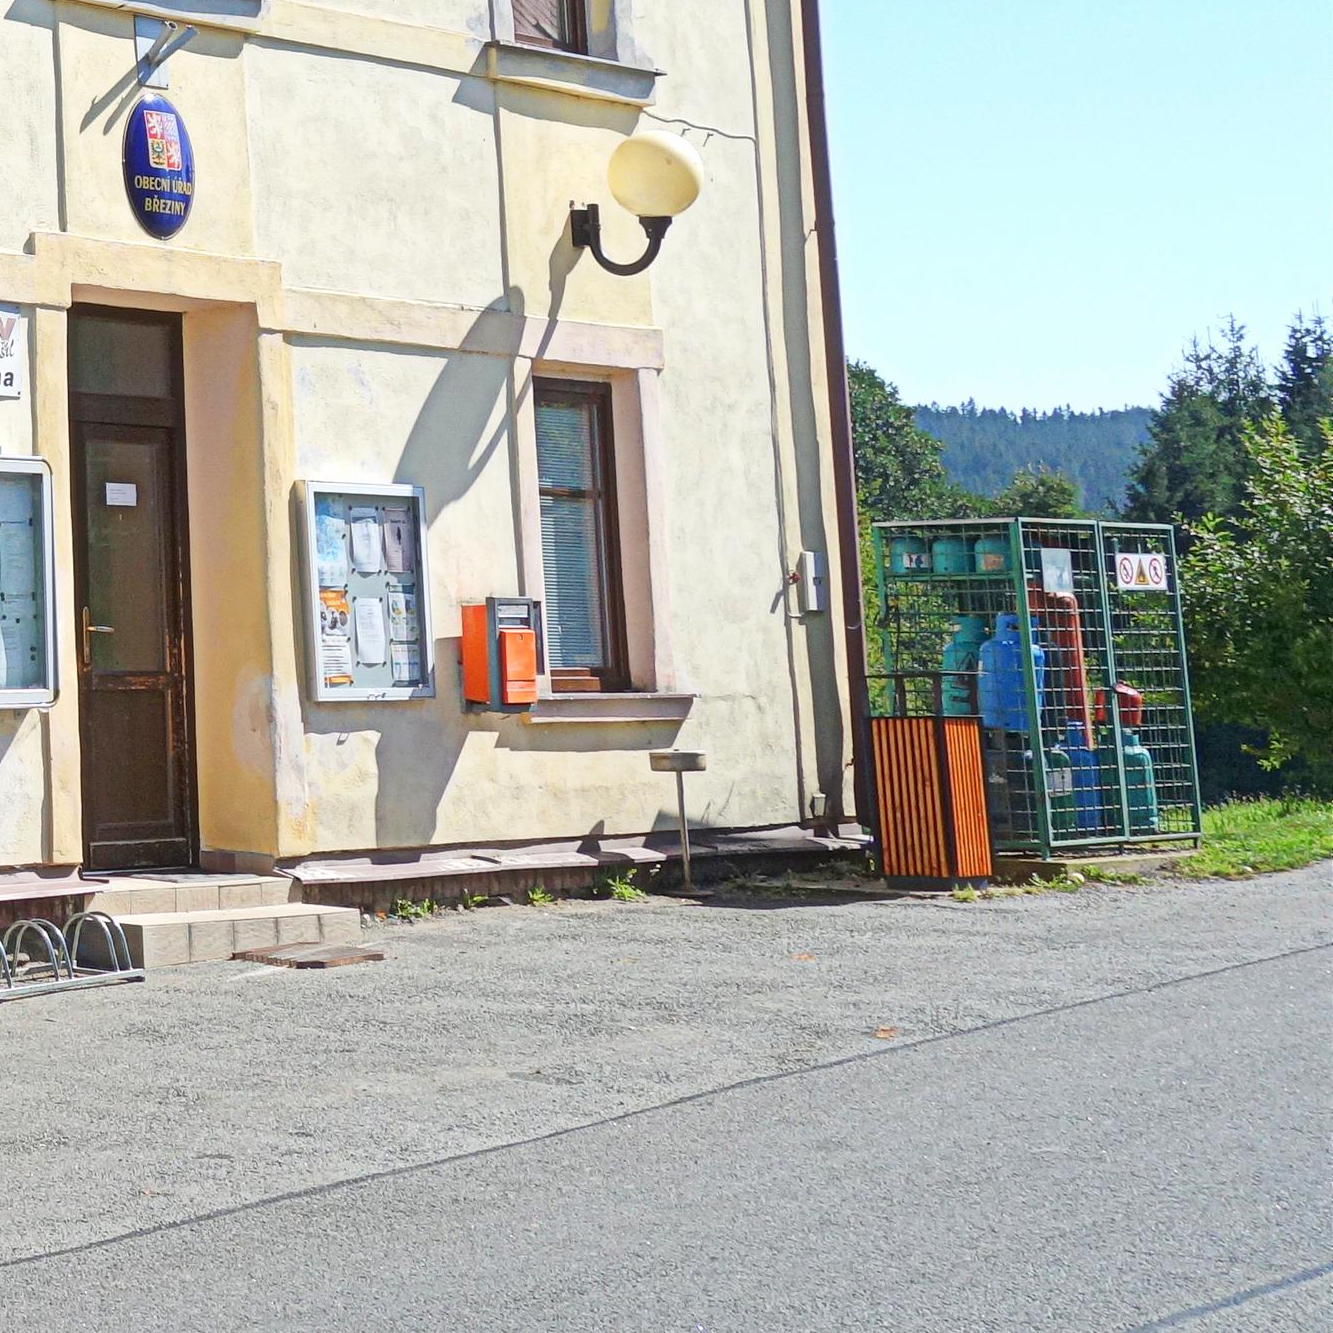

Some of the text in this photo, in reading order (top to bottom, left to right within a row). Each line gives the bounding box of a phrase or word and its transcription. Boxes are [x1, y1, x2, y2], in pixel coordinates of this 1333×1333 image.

[134, 175, 192, 195] OBECNÍ ÚŘAD
[145, 195, 185, 215] BŘEZINY
